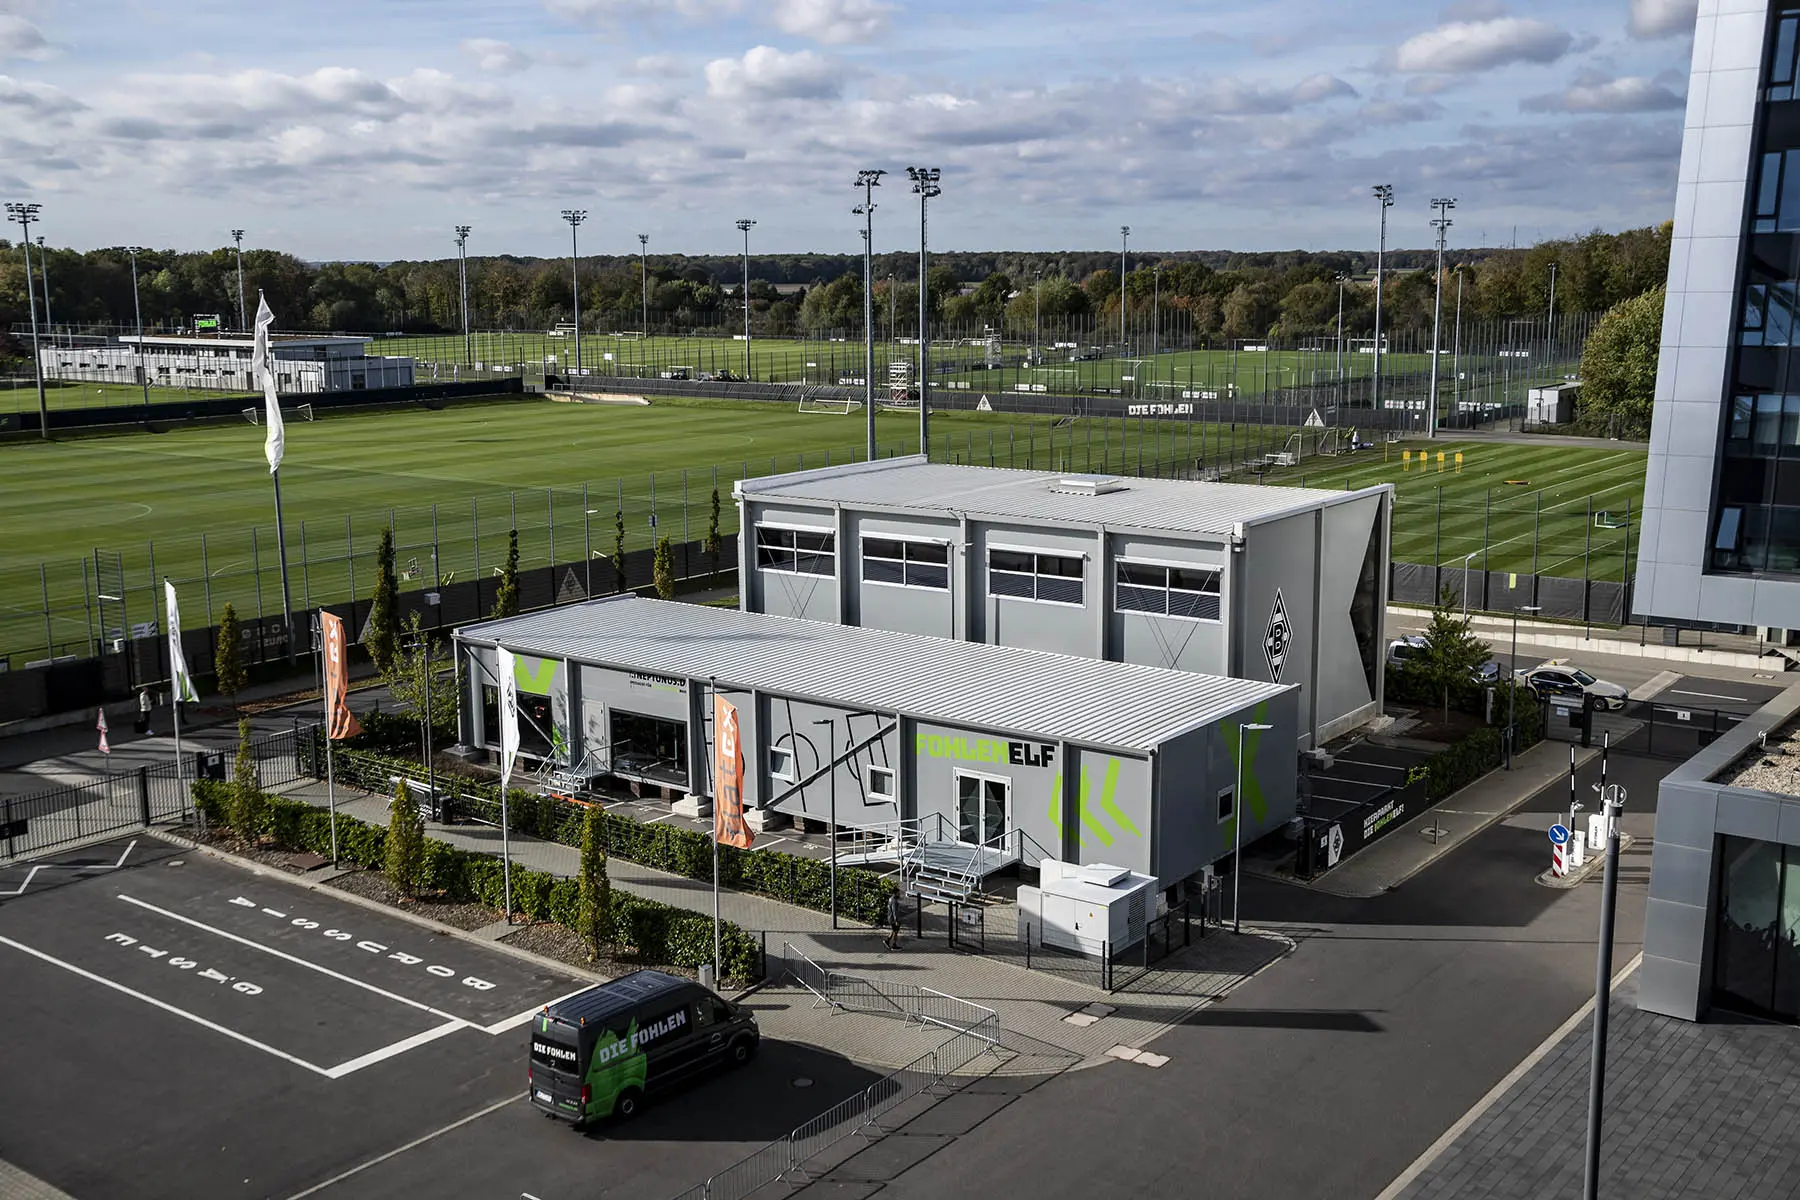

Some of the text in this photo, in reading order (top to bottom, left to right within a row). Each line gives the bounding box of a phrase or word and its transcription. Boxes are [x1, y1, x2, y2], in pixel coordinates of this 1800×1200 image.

[1128, 404, 1148, 415] DIE
[916, 733, 1055, 767] FOHLENELF
[104, 932, 264, 995] GÄSTE
[228, 896, 496, 990] BORUSSIA
[534, 1042, 576, 1062] DIE FOHLEN
[599, 1009, 687, 1064] DIE FOHLEN
